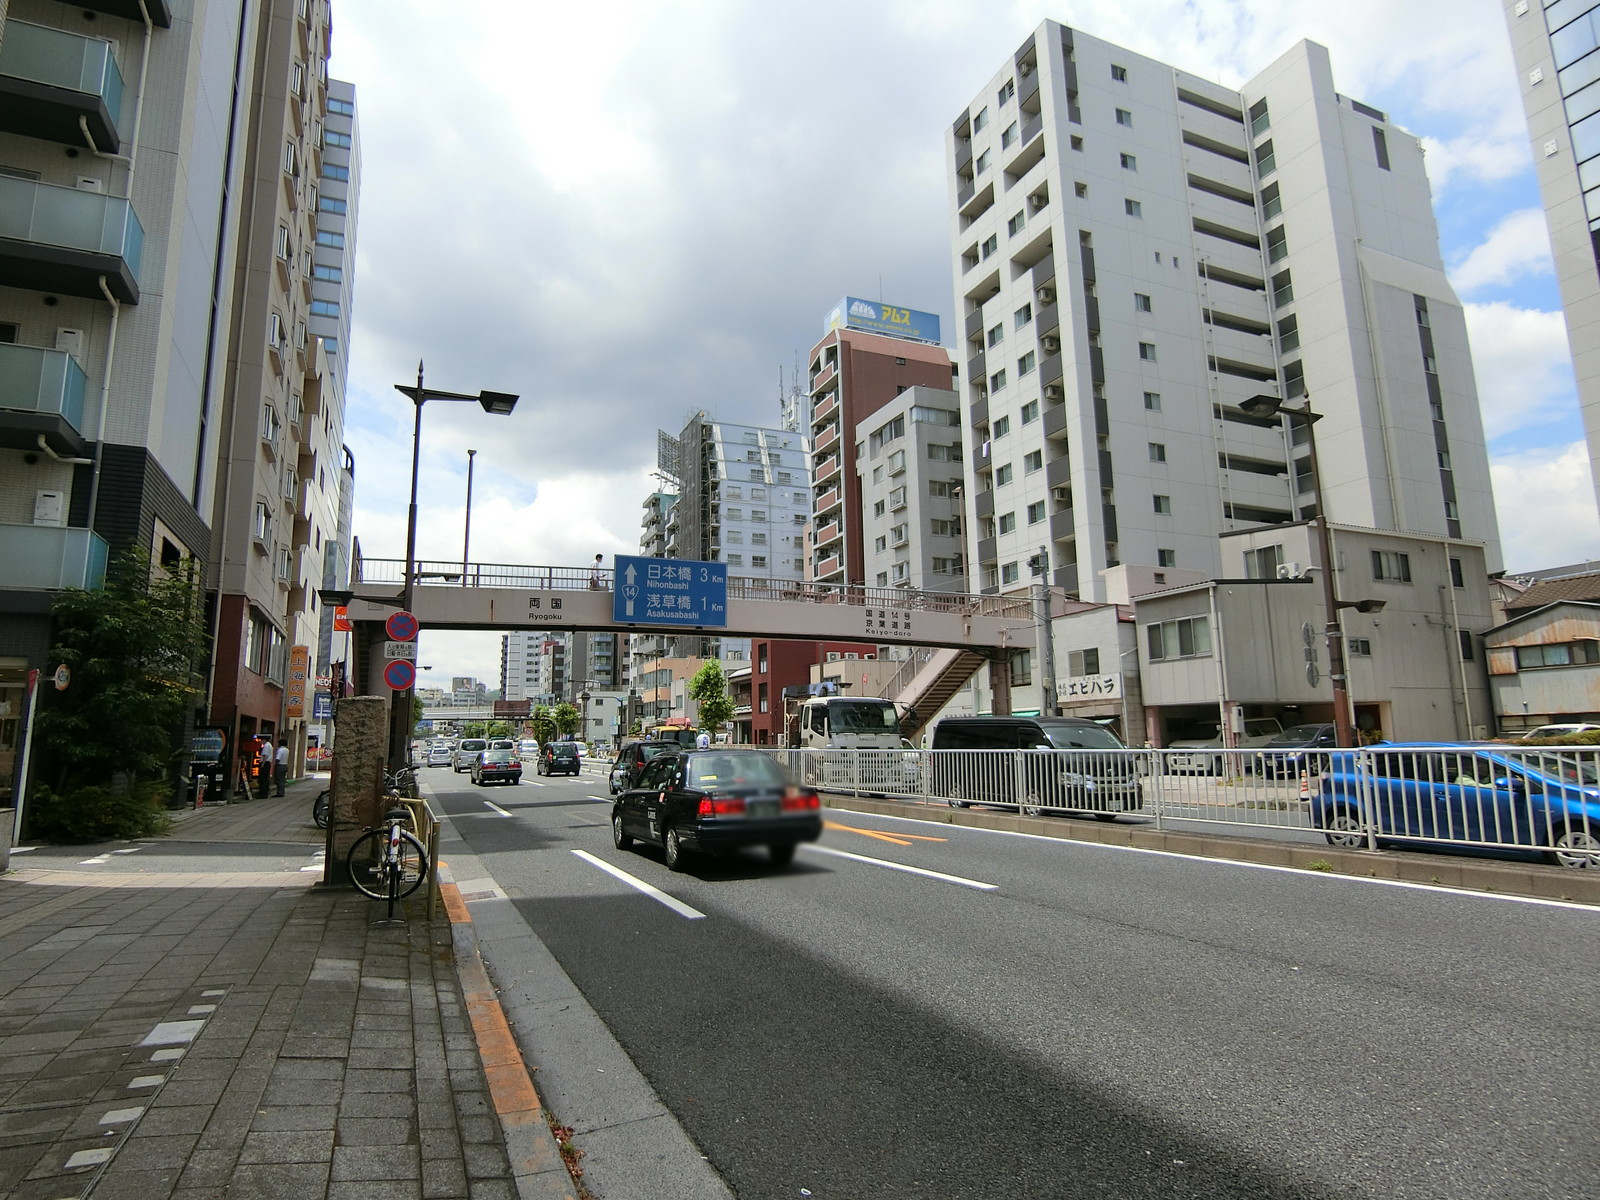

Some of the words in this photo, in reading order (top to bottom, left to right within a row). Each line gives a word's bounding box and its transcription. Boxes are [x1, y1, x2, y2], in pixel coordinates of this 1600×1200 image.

[881, 305, 911, 326] アムス
[648, 564, 692, 581] 日本橋
[700, 567, 708, 583] 3
[712, 575, 724, 583] Km
[646, 579, 689, 590] Nihonbashi
[625, 586, 636, 597] 14
[529, 597, 562, 609] 両国
[646, 593, 691, 610] 浅草橋
[700, 596, 707, 611] 1
[712, 604, 724, 612] Km
[528, 612, 562, 620] Ryogoku
[646, 609, 700, 620] Asakusabashi
[865, 619, 911, 630] 京葉道路
[865, 628, 912, 637] Keiyo-doro
[1069, 677, 1115, 696] エビハラ
